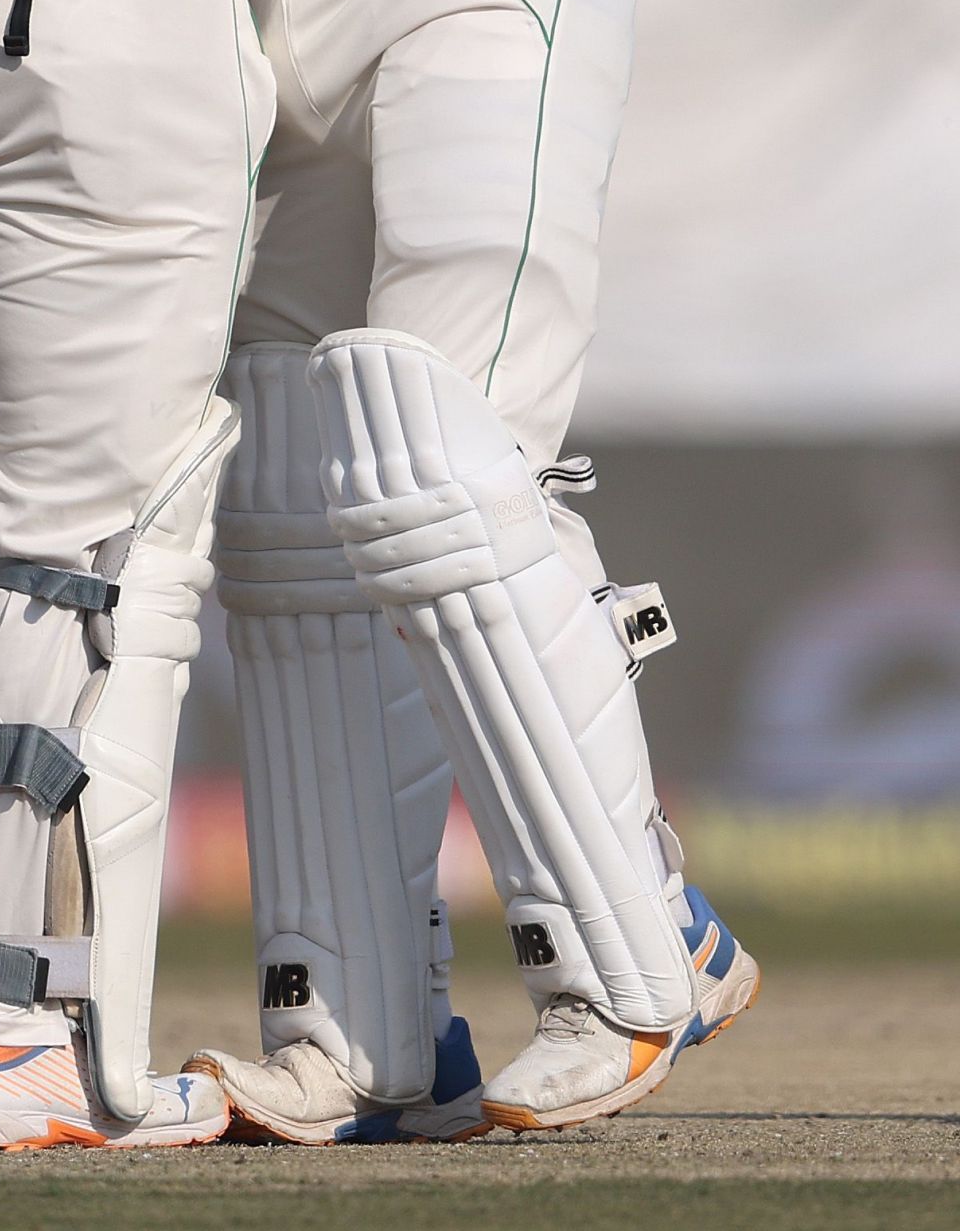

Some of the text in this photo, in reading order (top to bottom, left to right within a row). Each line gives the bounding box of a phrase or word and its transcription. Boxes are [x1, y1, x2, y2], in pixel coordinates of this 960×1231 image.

[623, 605, 668, 645] MB
[510, 922, 555, 966] MB
[263, 962, 311, 1008] MB
